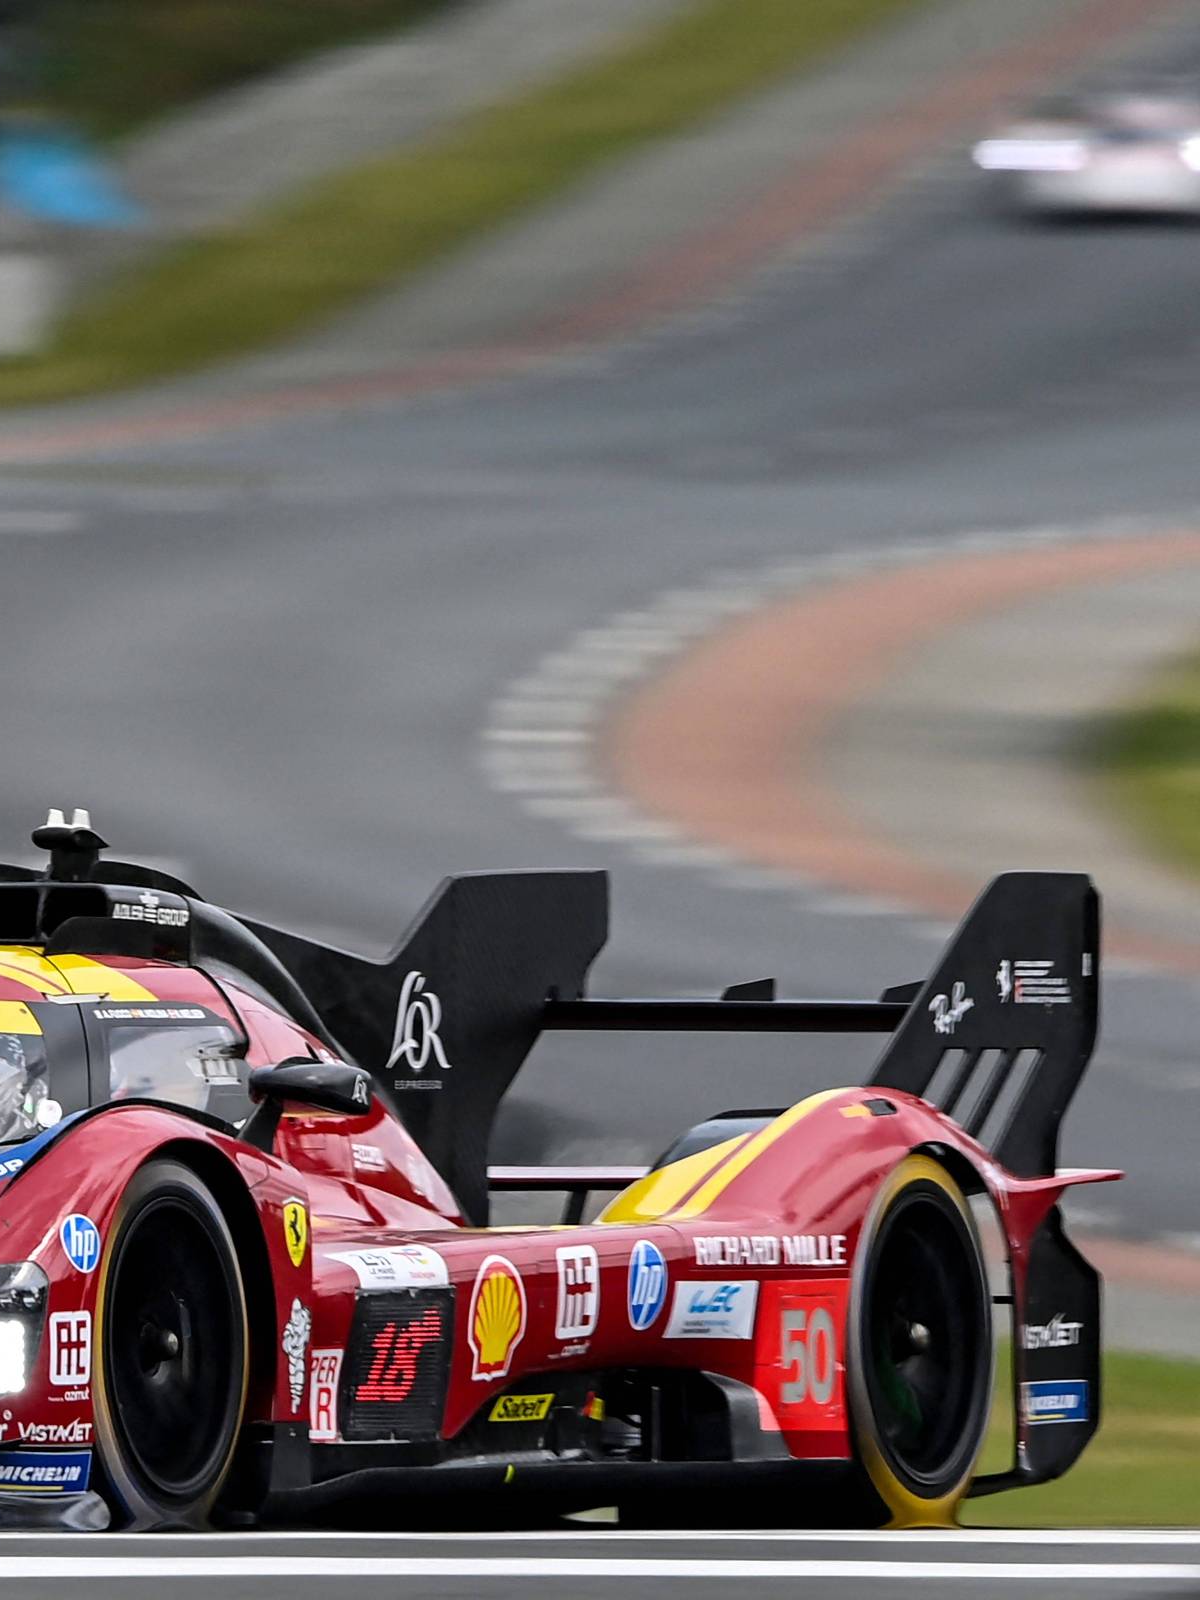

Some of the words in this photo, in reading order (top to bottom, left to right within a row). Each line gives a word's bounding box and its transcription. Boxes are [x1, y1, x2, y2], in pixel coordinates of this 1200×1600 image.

[157, 907, 190, 927] GROUP
[62, 1214, 99, 1272] hp
[692, 1235, 782, 1265] RICHARD
[782, 1235, 847, 1265] MILLE
[629, 1241, 666, 1329] hp
[781, 1307, 836, 1405] 50
[17, 1417, 93, 1442] VISTAJET
